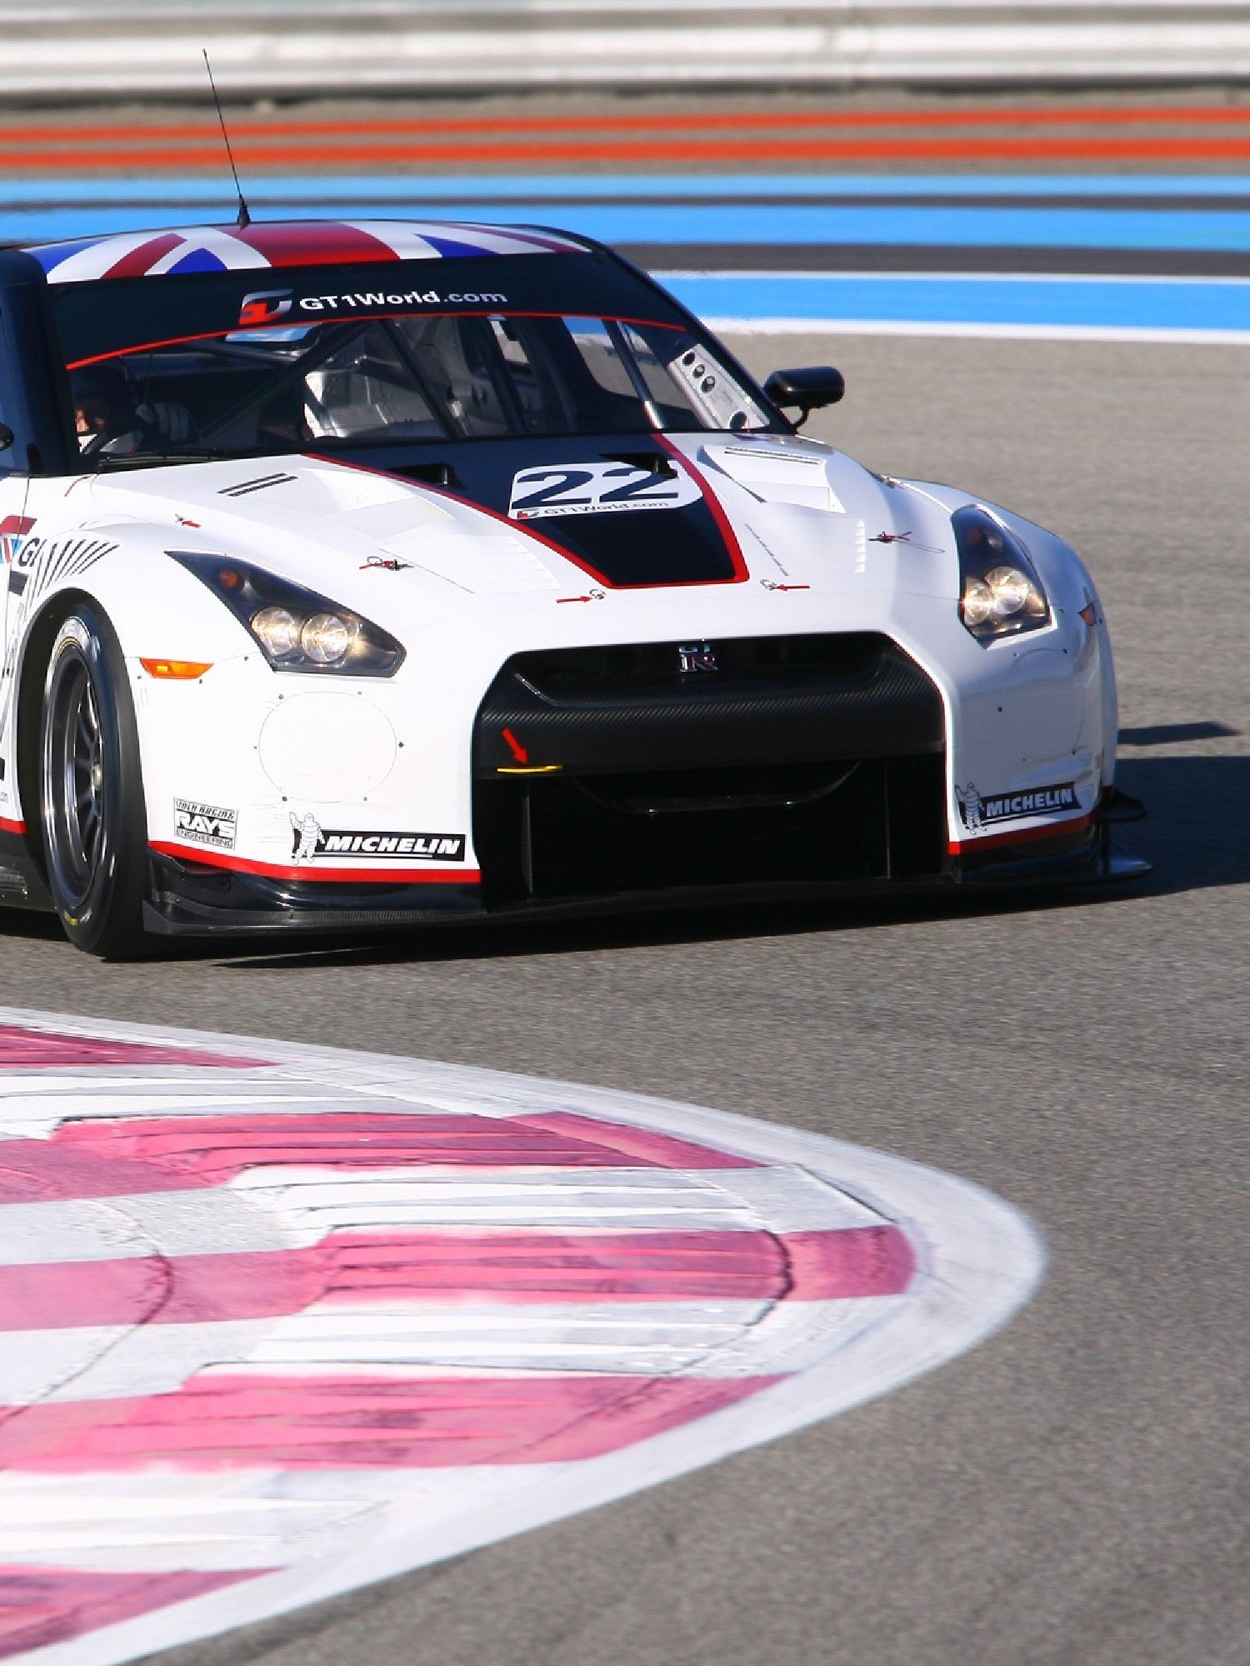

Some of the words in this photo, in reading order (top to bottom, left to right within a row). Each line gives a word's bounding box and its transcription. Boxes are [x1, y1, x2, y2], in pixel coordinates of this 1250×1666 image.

[299, 291, 508, 310] GT1World.com
[512, 469, 679, 509] 22
[986, 788, 1073, 817] MICHELIN
[176, 811, 235, 839] RAYS
[324, 835, 461, 855] MICHELIN
